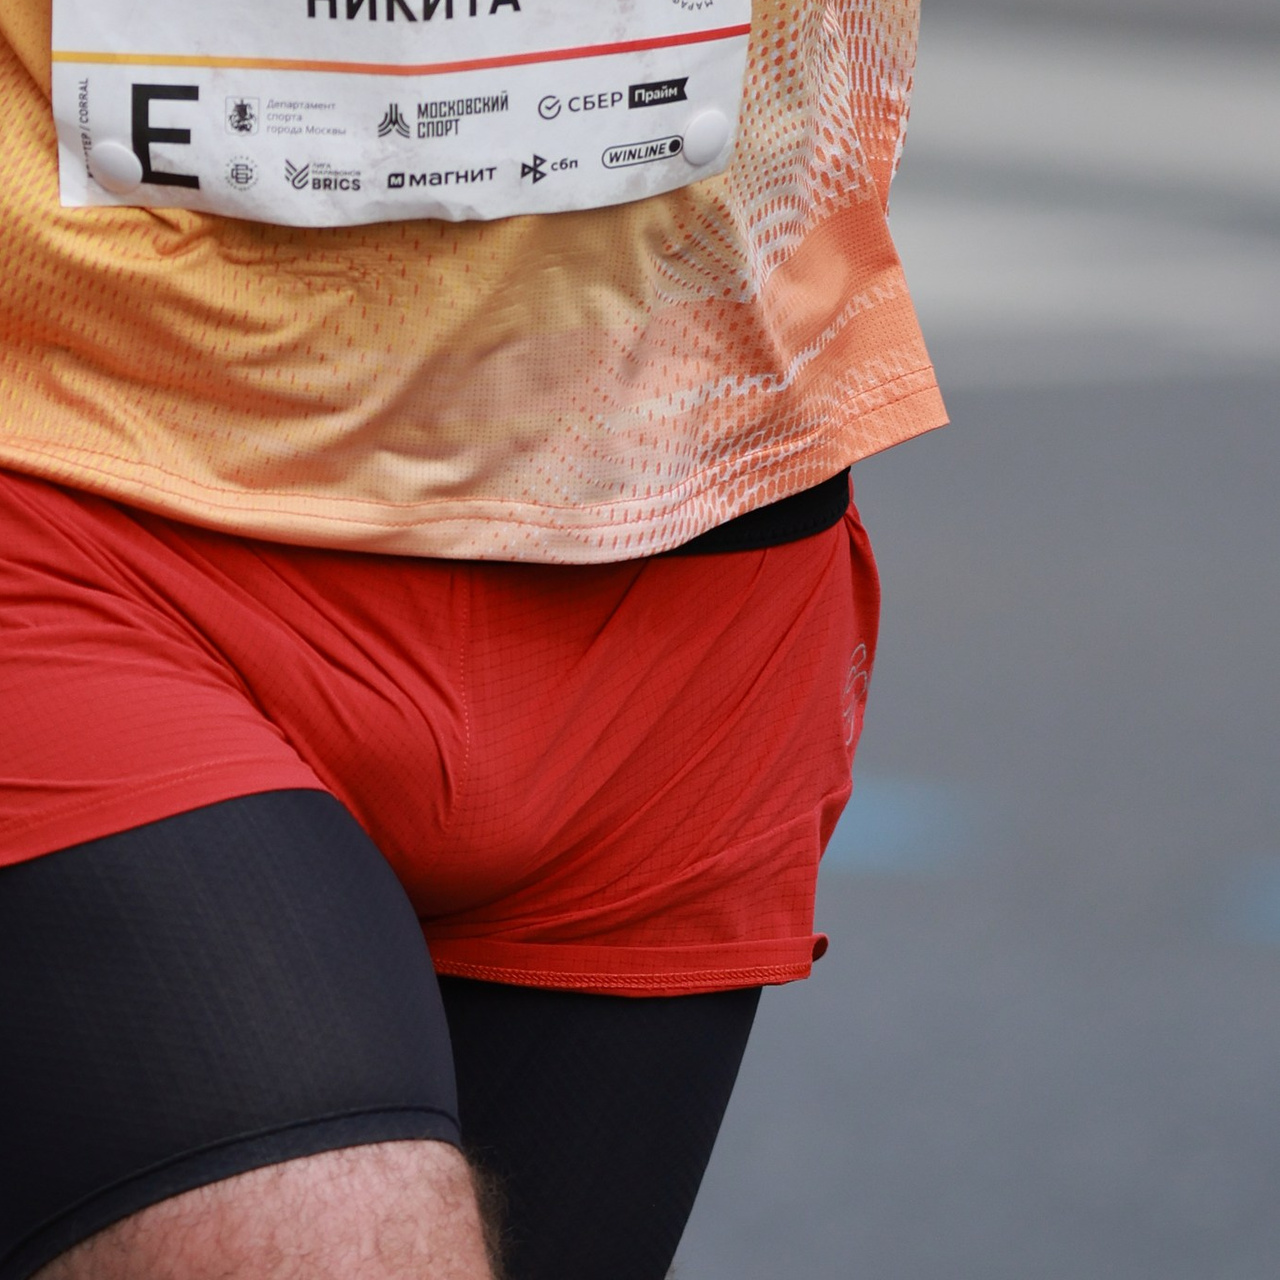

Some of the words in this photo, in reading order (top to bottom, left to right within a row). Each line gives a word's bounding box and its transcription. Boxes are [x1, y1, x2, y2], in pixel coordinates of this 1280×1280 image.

[79, 78, 89, 124] CORRAL
[266, 99, 336, 110] Департамент
[417, 90, 509, 119] МОСКОВСКИЙ
[568, 91, 623, 112] СБЕР
[634, 85, 678, 103] Прайм
[266, 112, 303, 122] спорта
[266, 125, 302, 135] города
[305, 125, 346, 135] Москвы
[417, 118, 460, 139] СПОРТ
[609, 142, 666, 163] WINLINE
[551, 158, 578, 171] сбп
[312, 178, 362, 191] BRICS
[409, 167, 497, 187] магнит
